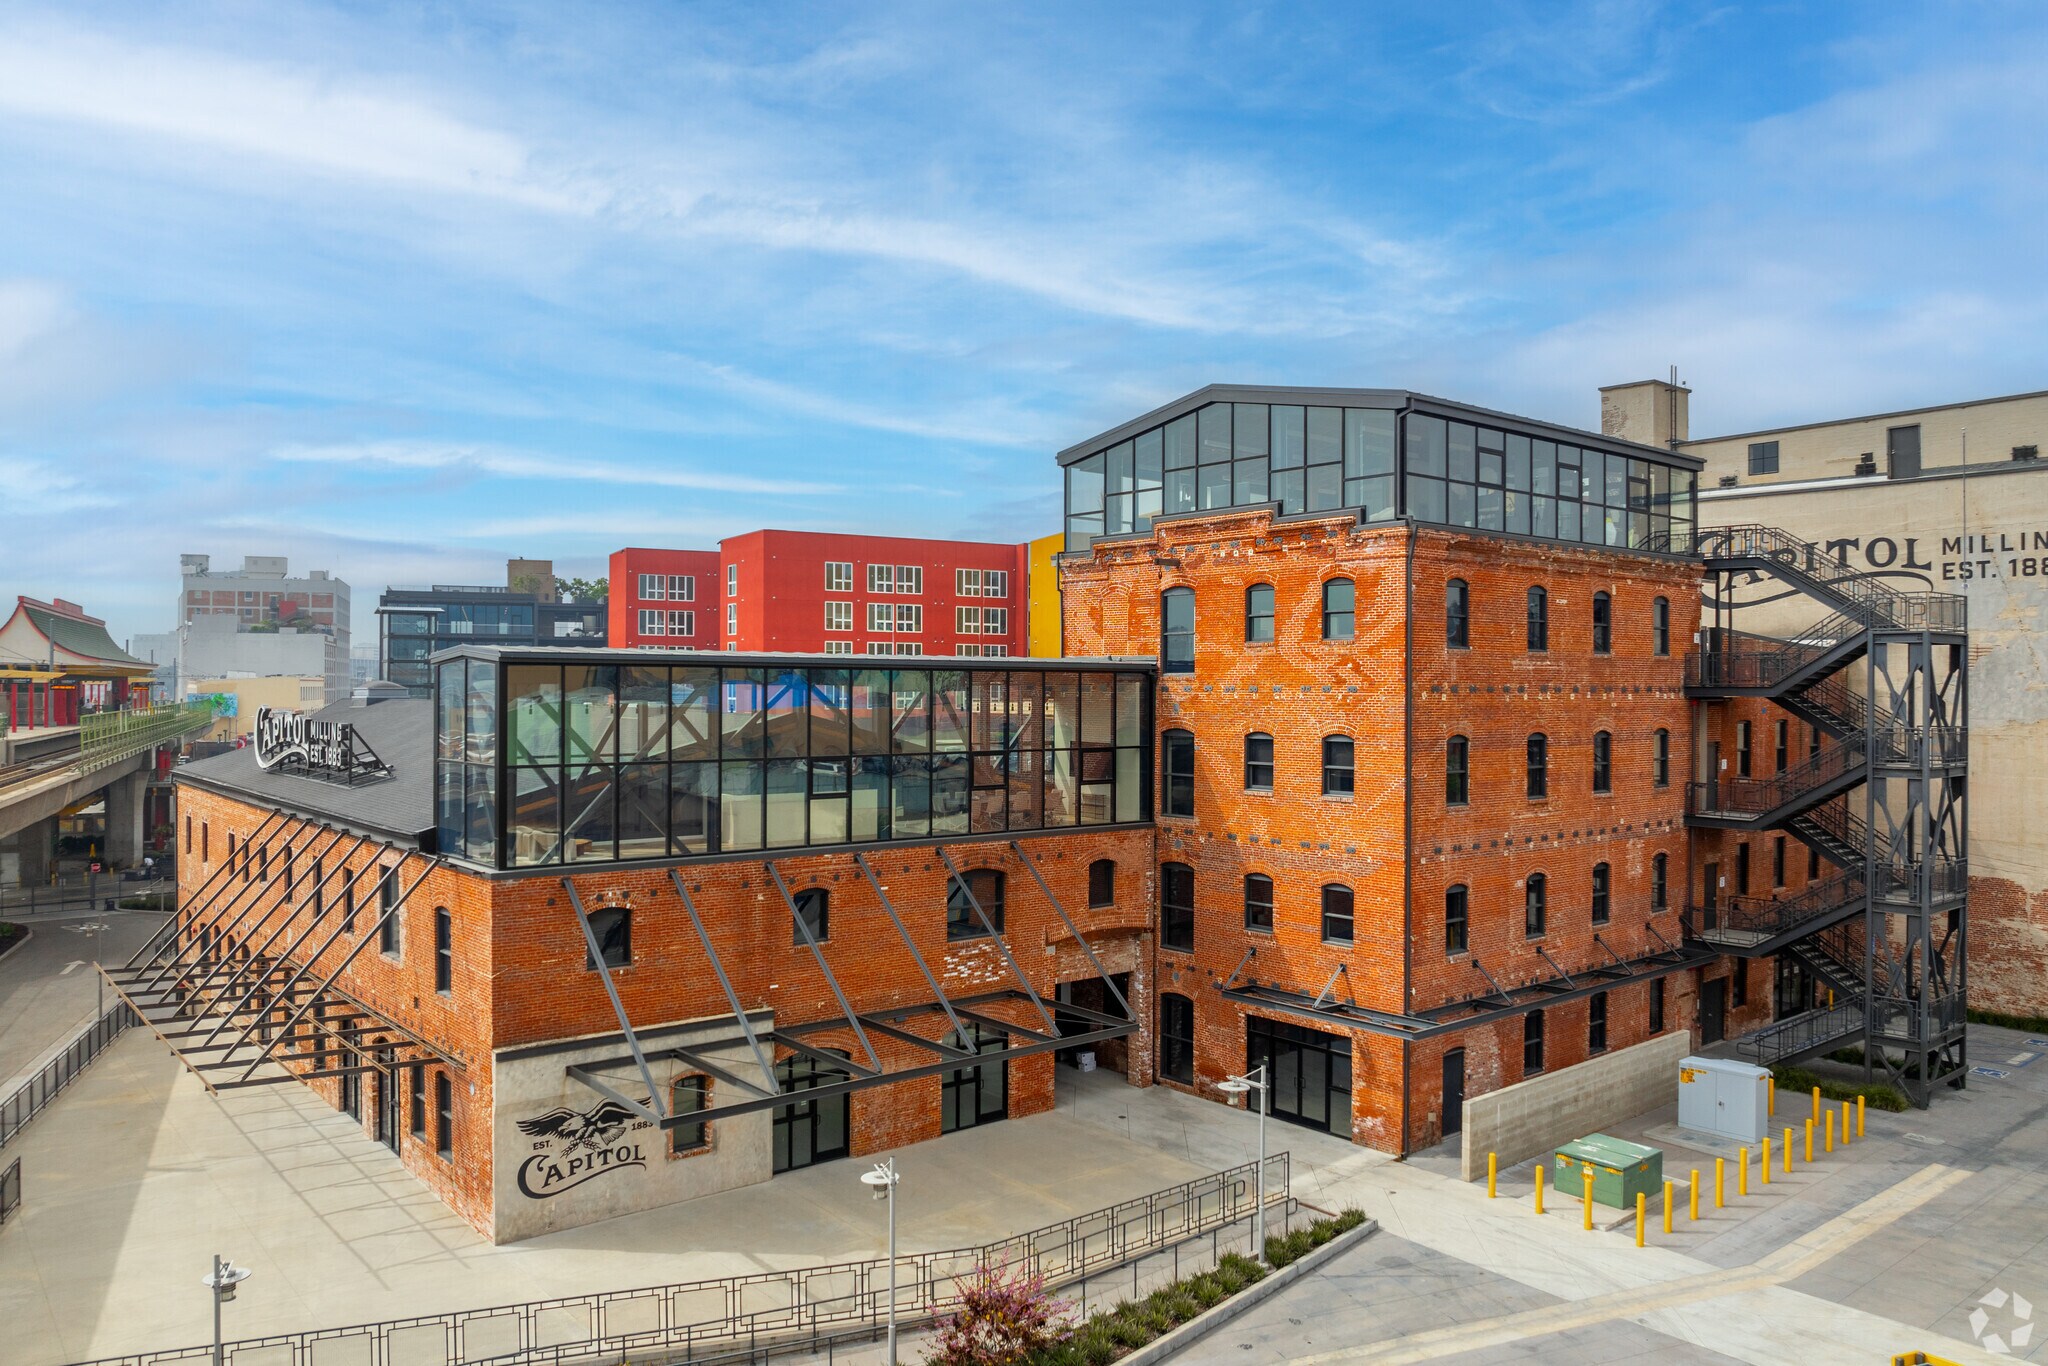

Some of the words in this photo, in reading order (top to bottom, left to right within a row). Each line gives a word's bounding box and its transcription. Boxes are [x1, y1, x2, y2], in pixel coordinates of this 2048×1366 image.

[1942, 559, 1997, 581] EST.
[254, 704, 311, 769] CAPITOL
[310, 720, 341, 741] MILLING
[325, 746, 342, 767] 1883
[532, 1140, 553, 1151] EST.
[517, 1144, 646, 1199] CAPITOL
